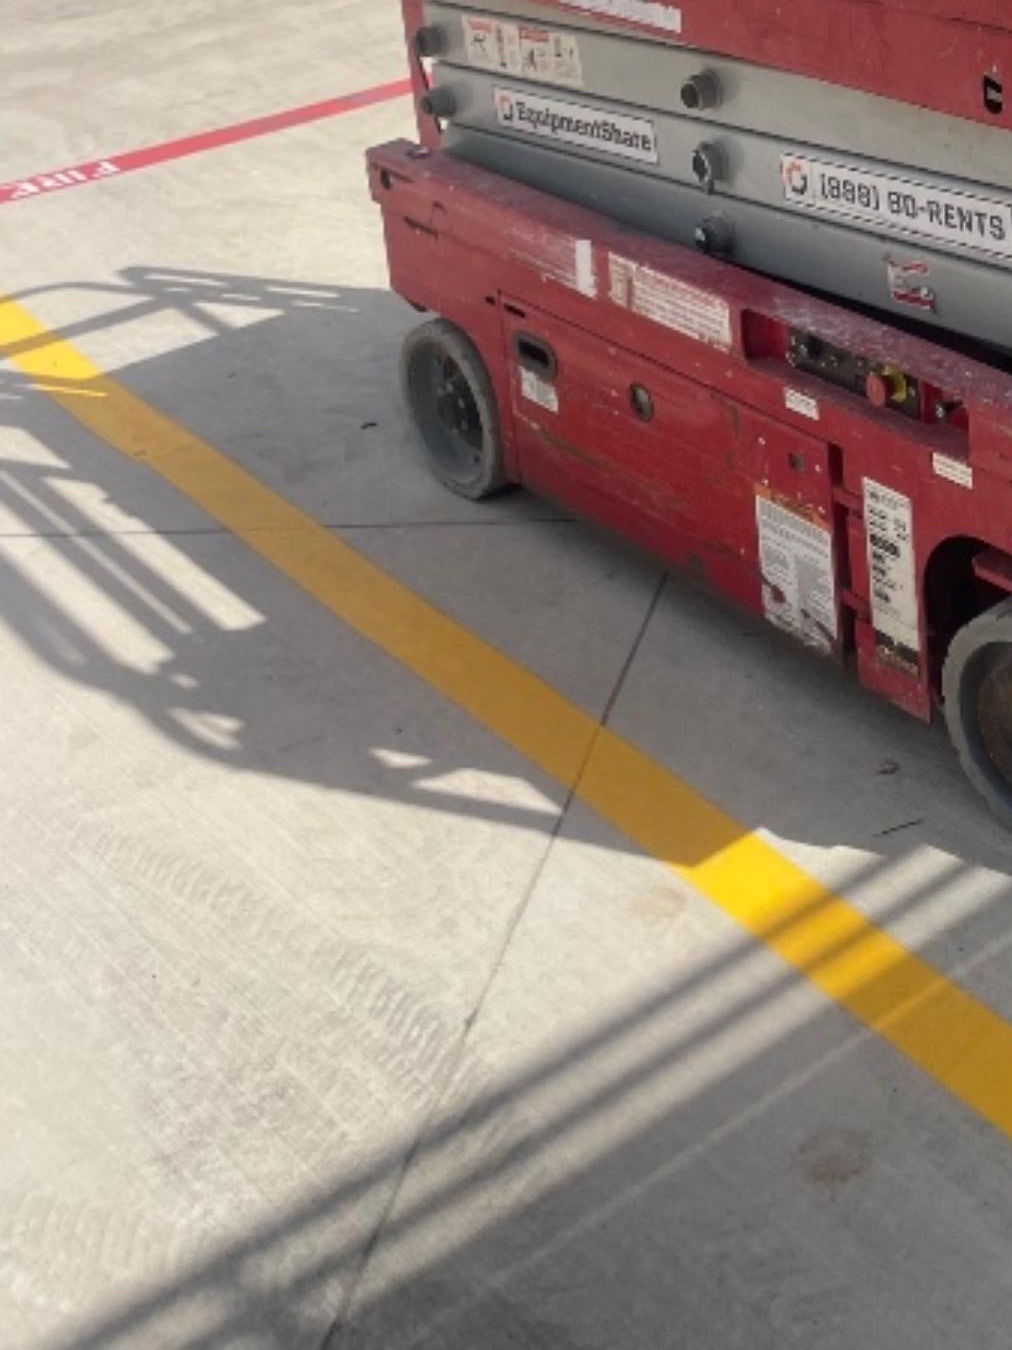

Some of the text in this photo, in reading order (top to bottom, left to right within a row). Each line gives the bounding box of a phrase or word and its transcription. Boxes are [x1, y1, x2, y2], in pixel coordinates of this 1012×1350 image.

[515, 101, 652, 151] EquipmentShare
[820, 173, 1006, 241] (888) 80-RENTS
